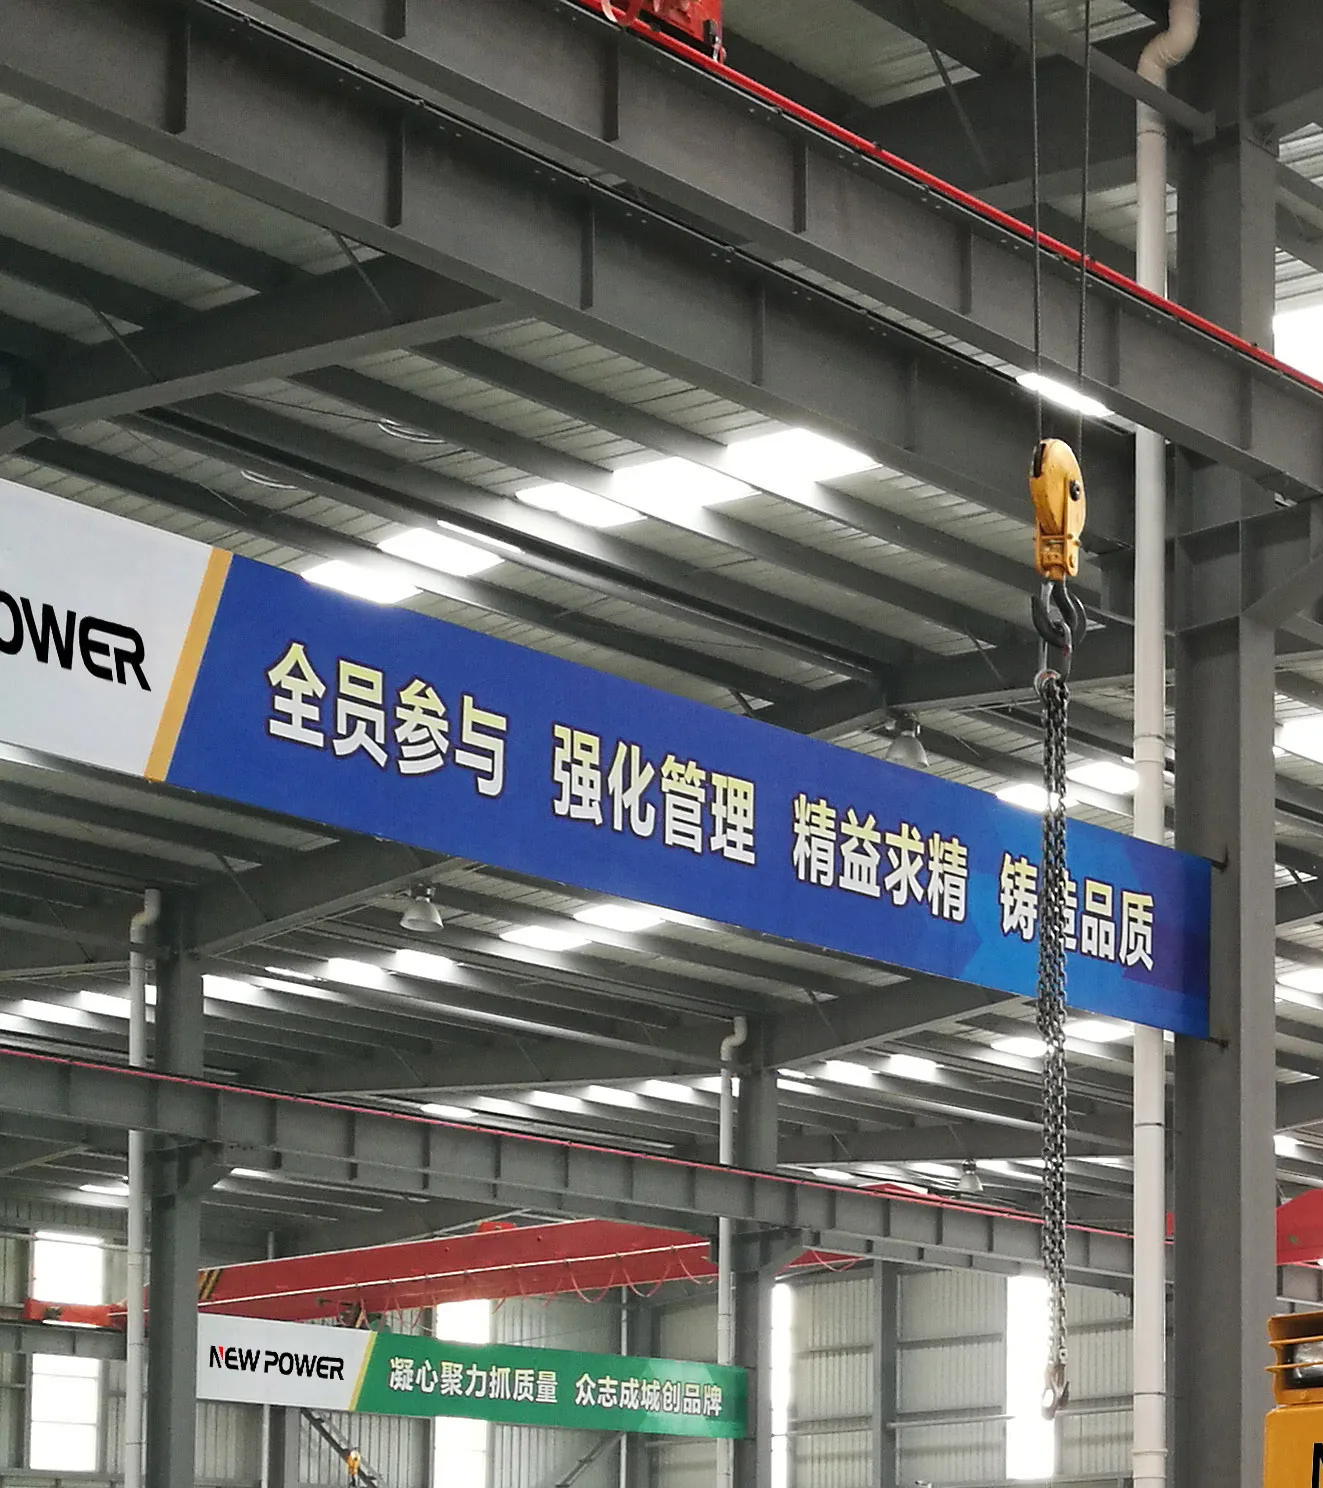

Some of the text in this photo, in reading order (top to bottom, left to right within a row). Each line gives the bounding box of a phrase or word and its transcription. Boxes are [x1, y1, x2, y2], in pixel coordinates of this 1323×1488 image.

[267, 642, 508, 797] 全员参与
[551, 724, 756, 864] 强化管理
[793, 794, 968, 922] 精益求精
[209, 1345, 344, 1380] NEW POWER
[389, 1357, 722, 1416] 凝心聚力抓质量 众志成城创品牌
